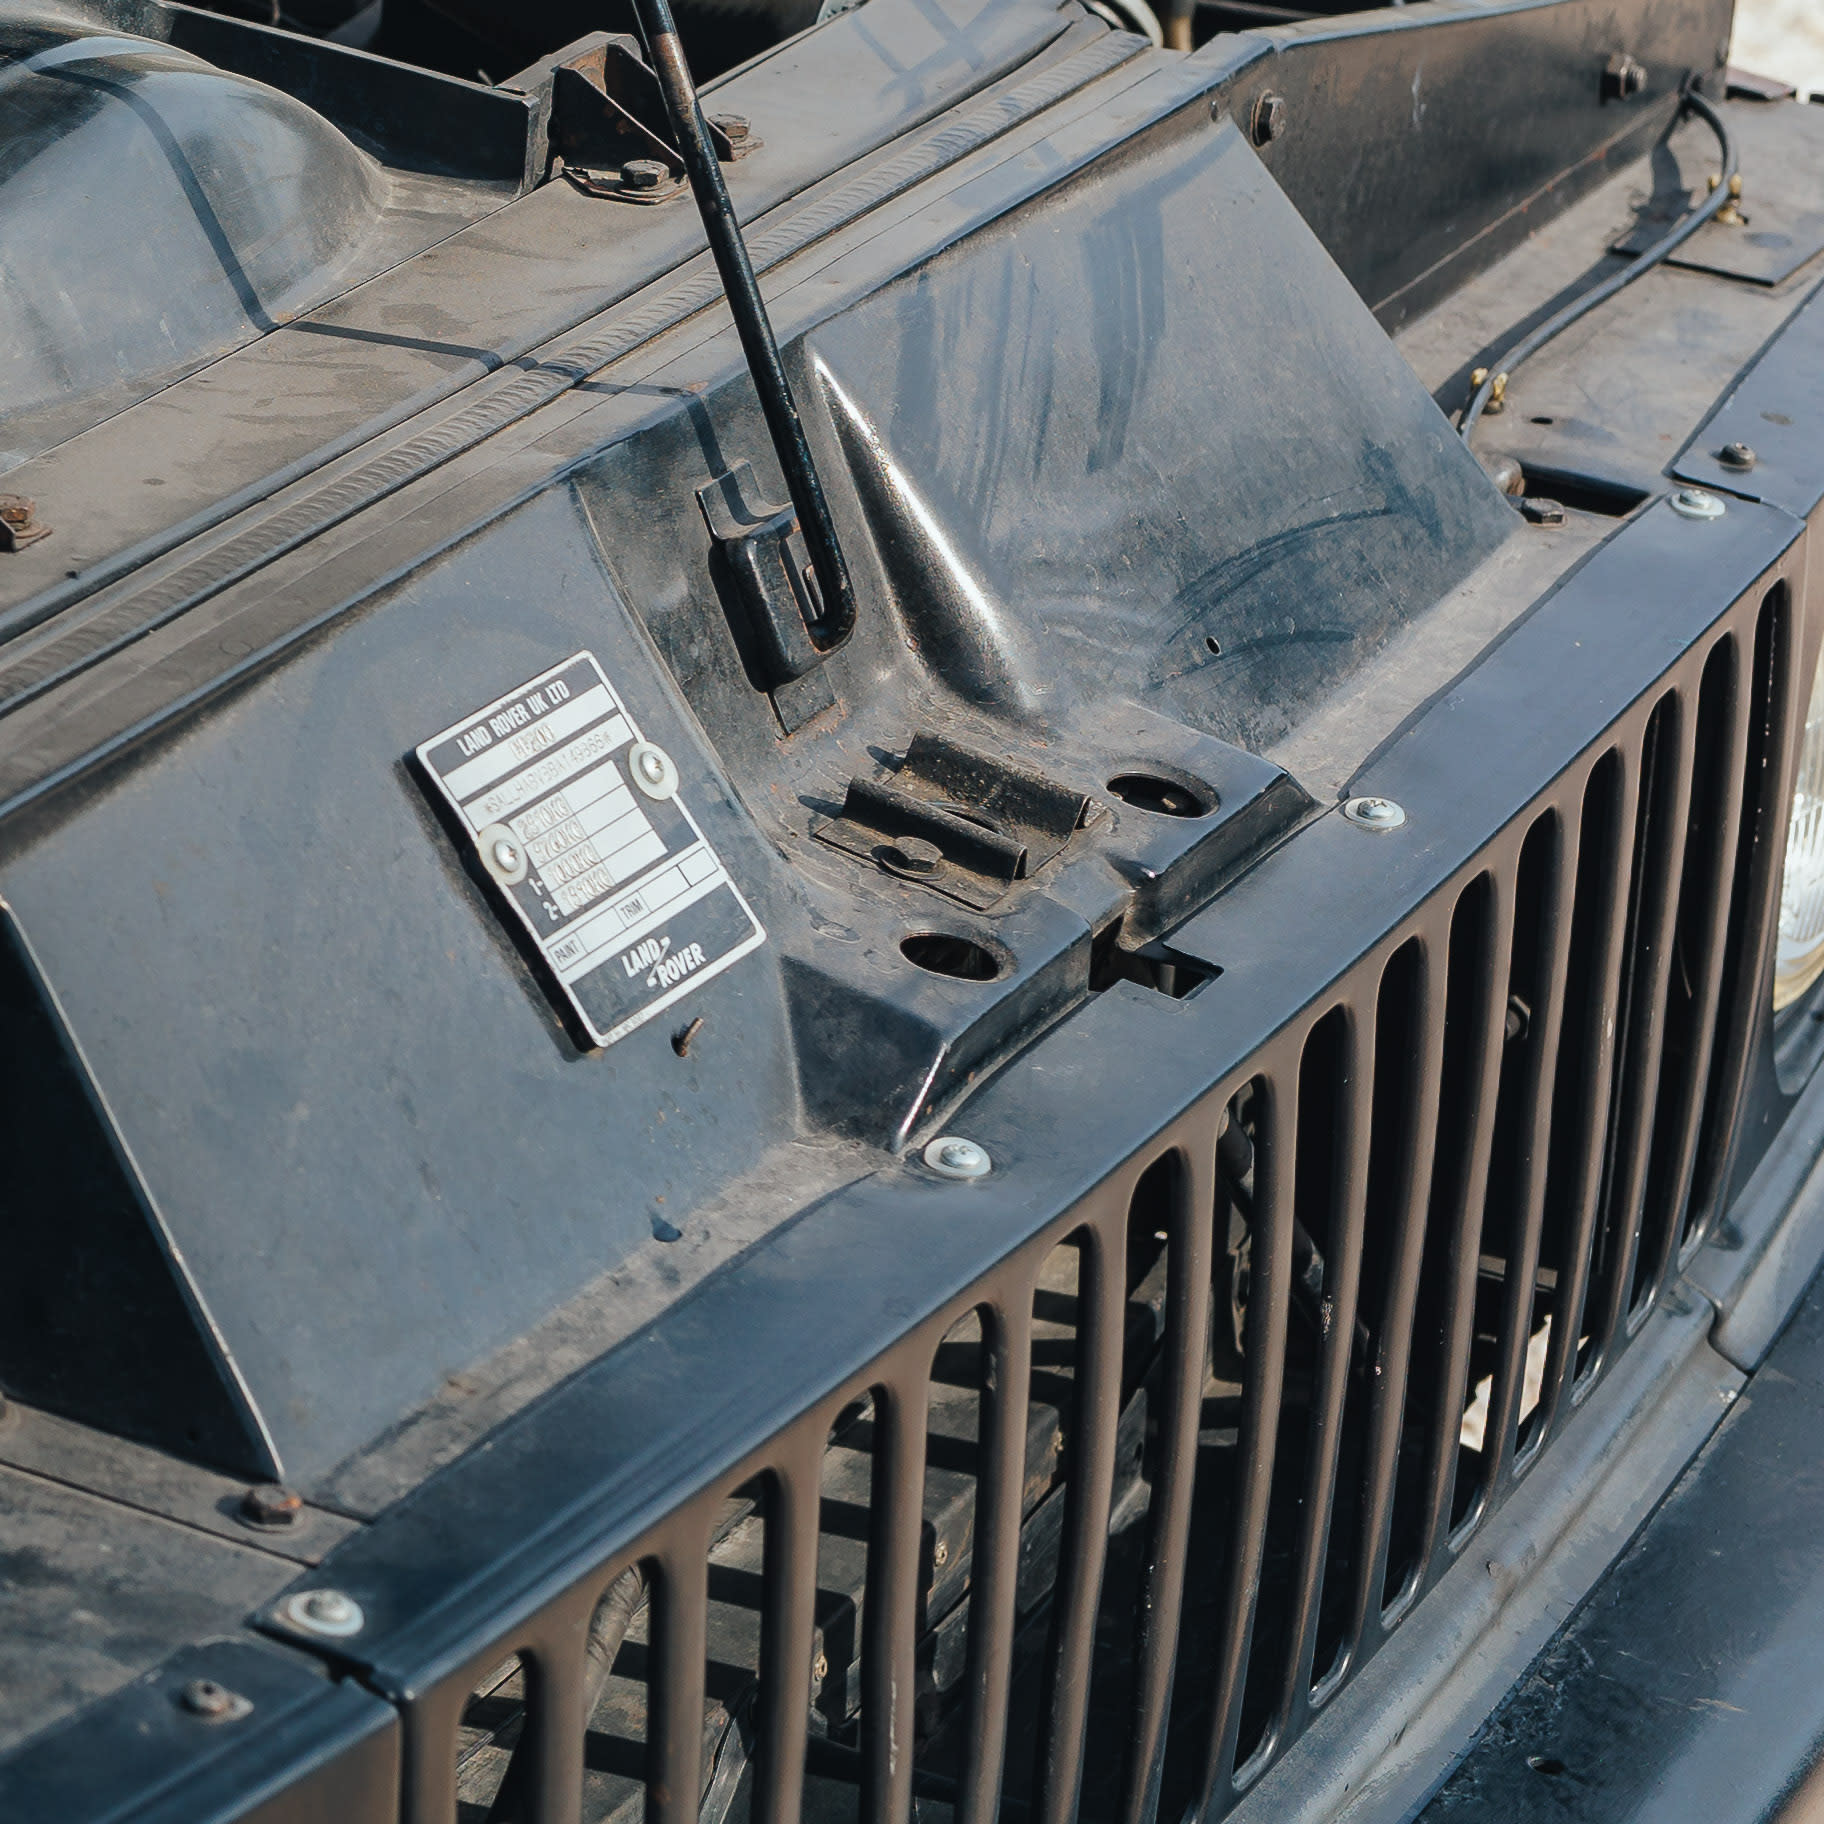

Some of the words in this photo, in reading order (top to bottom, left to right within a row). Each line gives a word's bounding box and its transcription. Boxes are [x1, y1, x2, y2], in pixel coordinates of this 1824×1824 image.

[455, 726, 491, 757] LAND
[489, 702, 530, 738] ROVER
[527, 691, 548, 716] UK
[545, 679, 570, 705] LTD
[554, 940, 578, 964] PAINT
[620, 898, 643, 920] TRIM
[621, 938, 659, 978] LAND
[658, 942, 706, 989] ROVER
